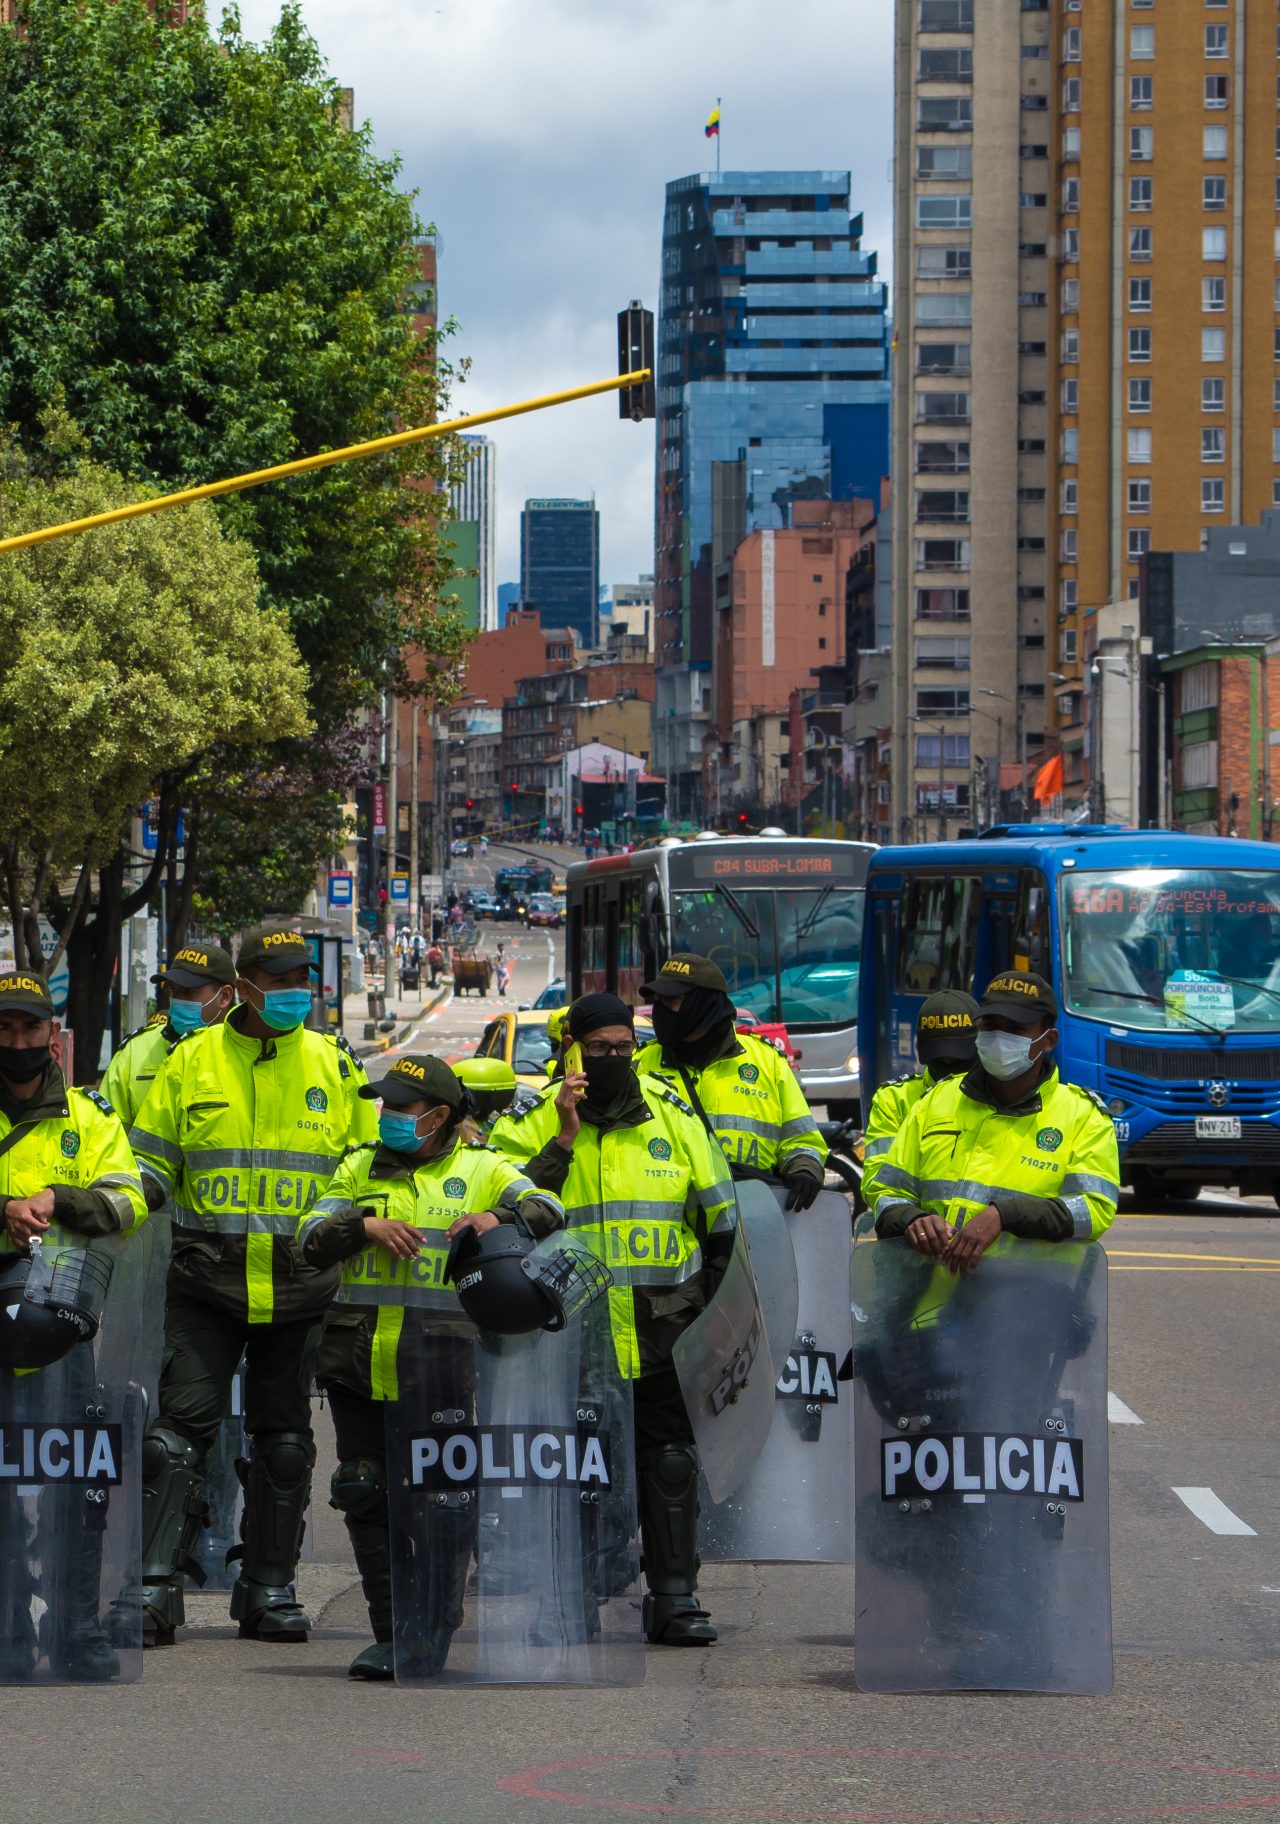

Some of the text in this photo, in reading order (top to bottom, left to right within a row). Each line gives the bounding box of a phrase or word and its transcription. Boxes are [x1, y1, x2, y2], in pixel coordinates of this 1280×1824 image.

[744, 856, 832, 873] SUBA-LOMBA
[1073, 888, 1124, 913] 56A
[986, 978, 1039, 998] POLICIA
[921, 1013, 972, 1030] POLICIA
[197, 1175, 318, 1211] POLICIA
[410, 1432, 610, 1485] POLICIA
[884, 1435, 1080, 1497] POLICIA
